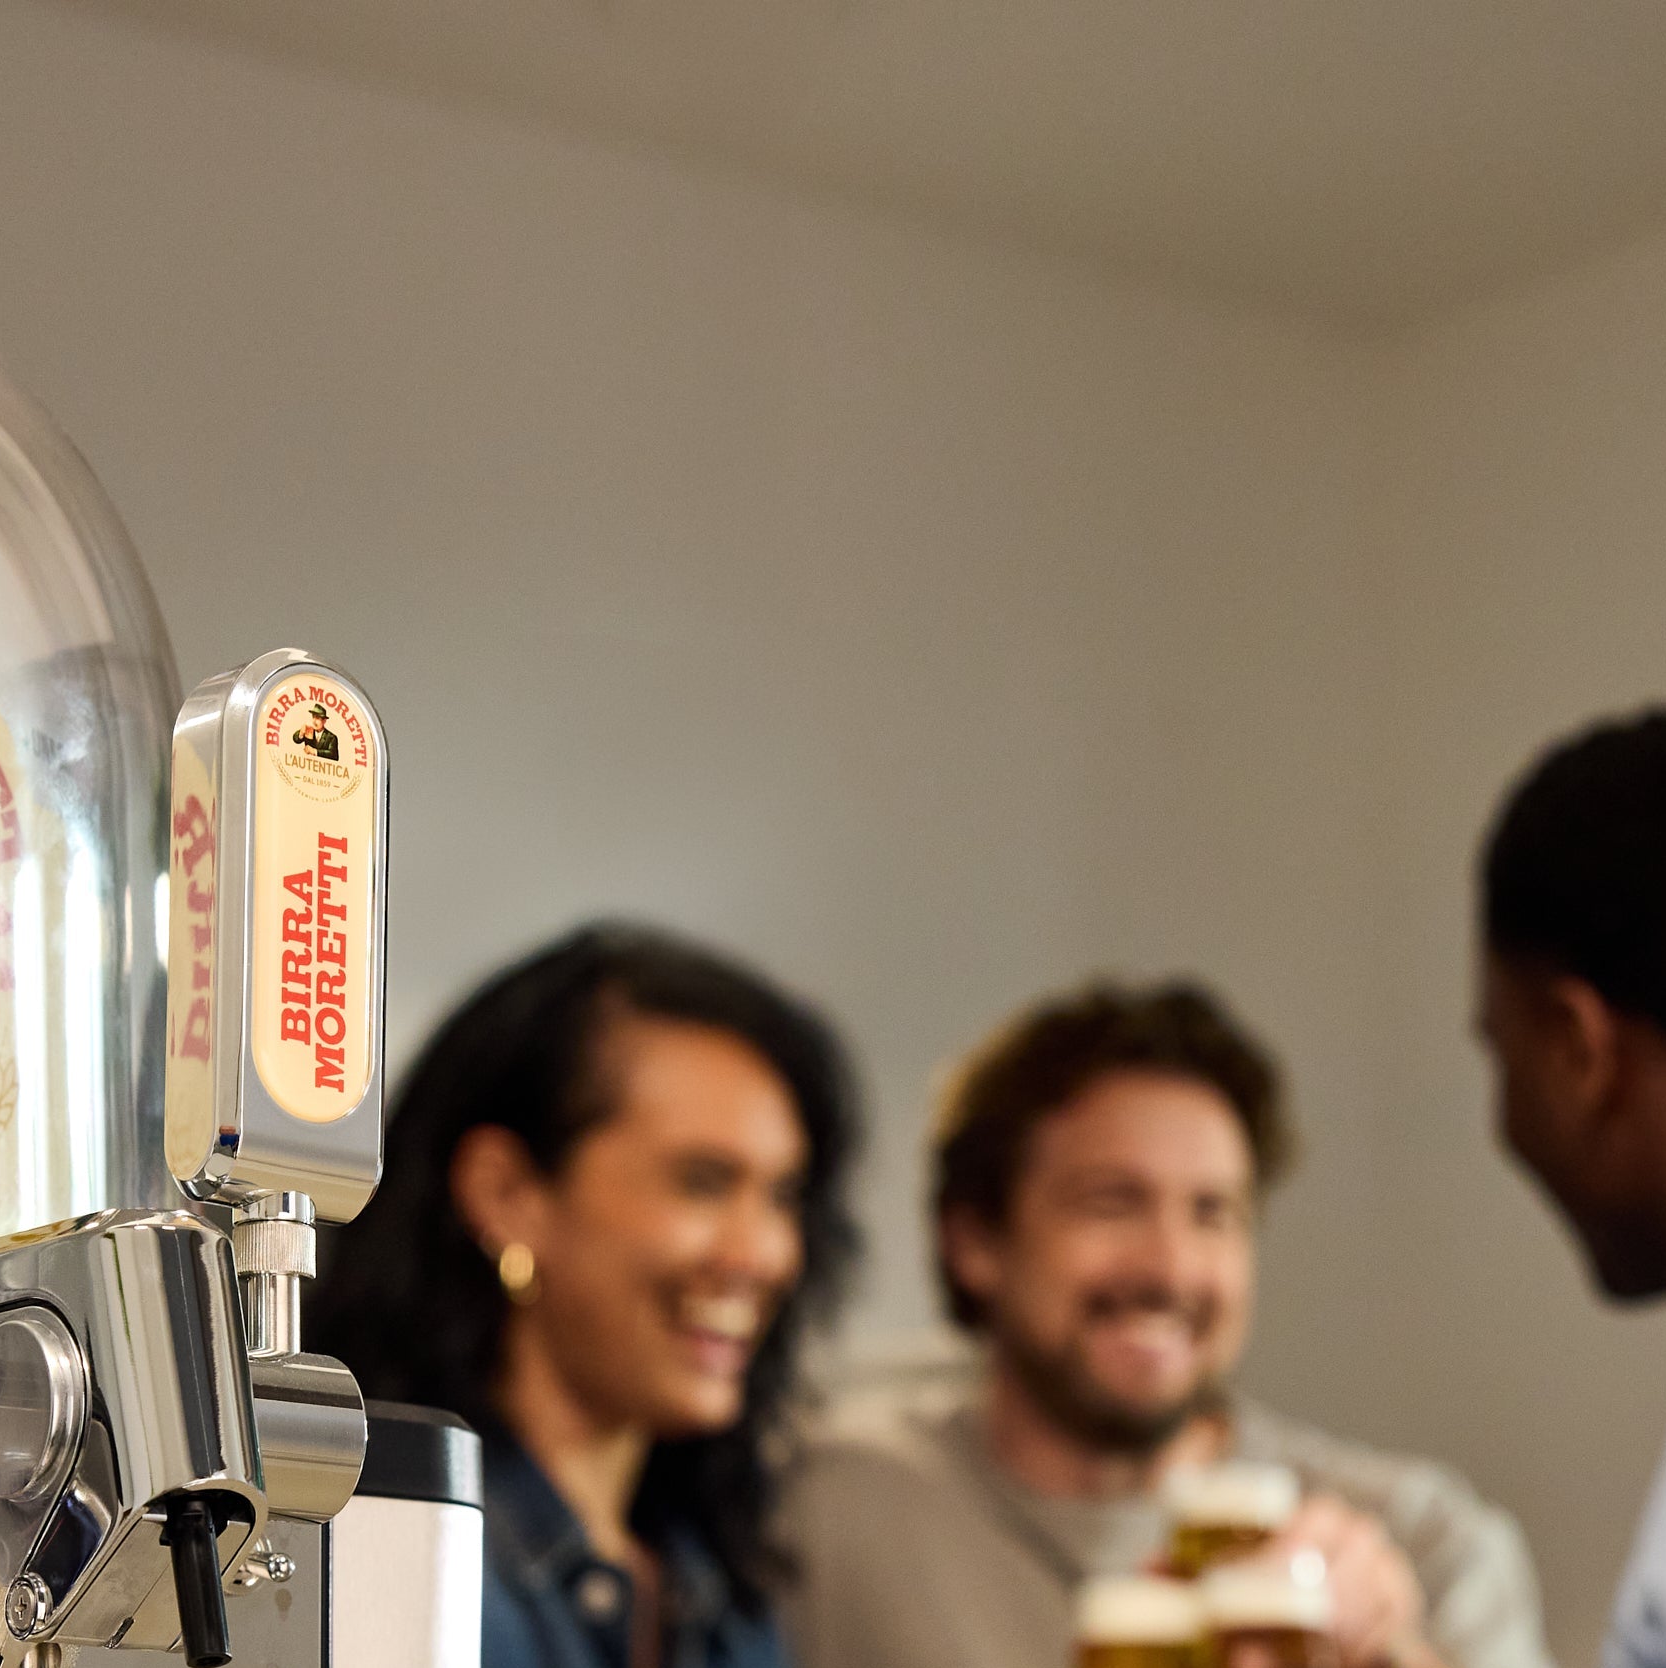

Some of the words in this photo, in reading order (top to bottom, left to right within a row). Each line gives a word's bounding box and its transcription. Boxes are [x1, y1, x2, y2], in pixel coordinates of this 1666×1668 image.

[266, 687, 306, 747] BIRRA
[309, 686, 367, 768] MORETTI
[285, 753, 350, 779] L'AUTENTICA
[281, 869, 313, 1046] BIRRA
[315, 832, 348, 1093] MORETTI
